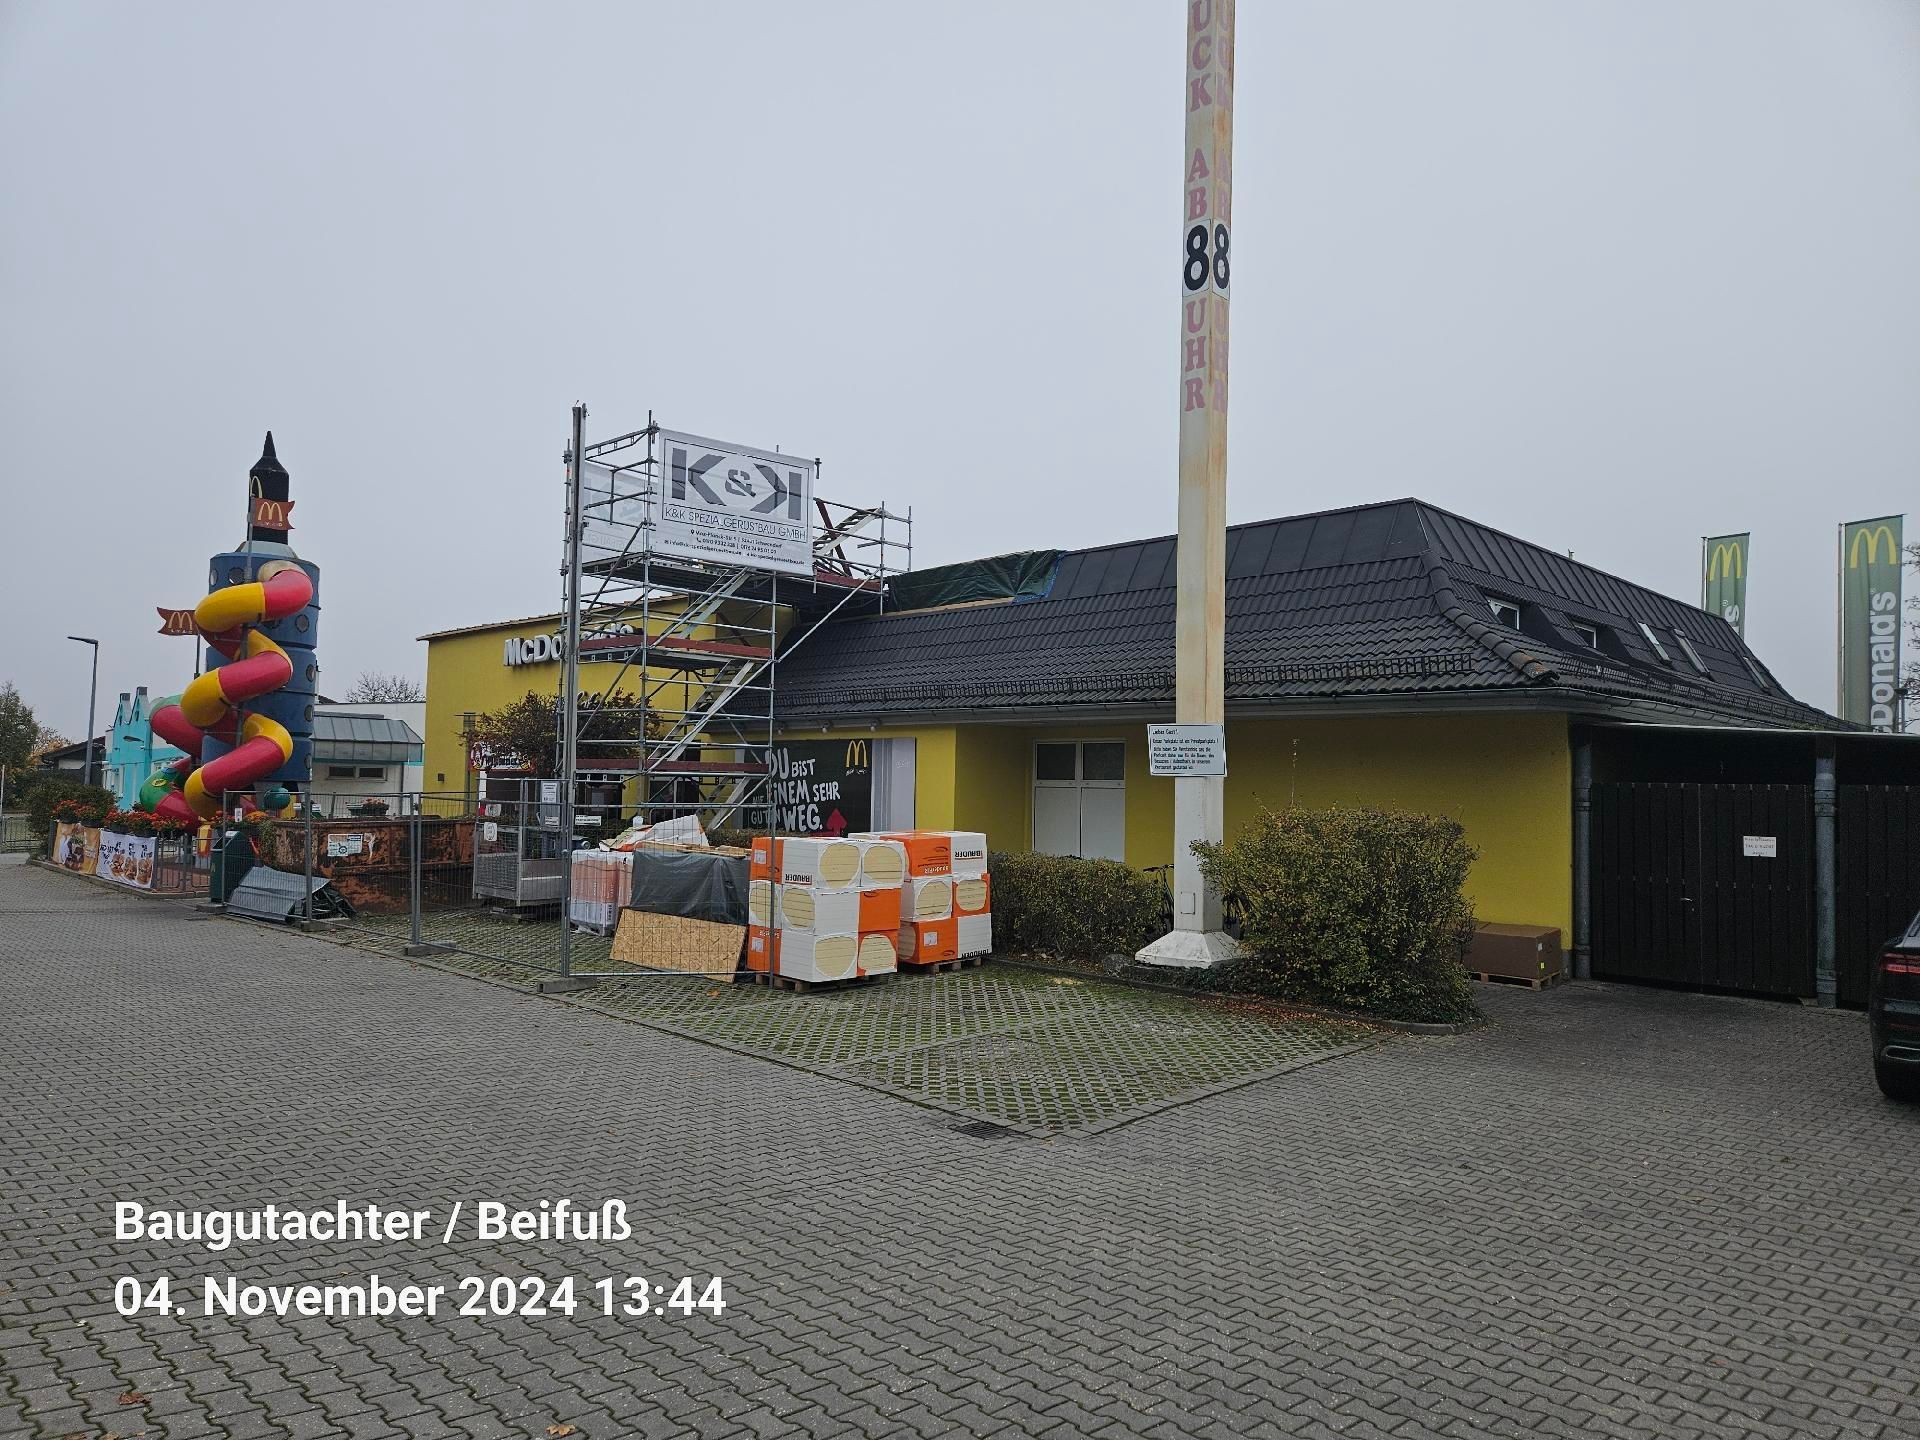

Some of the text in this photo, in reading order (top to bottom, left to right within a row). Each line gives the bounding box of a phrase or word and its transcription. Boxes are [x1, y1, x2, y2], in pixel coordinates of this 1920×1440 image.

[1188, 148, 1209, 221] AB
[1184, 224, 1209, 291] 8
[1213, 223, 1230, 290] 8
[1184, 298, 1207, 412] UHR
[765, 747, 789, 779] DU
[813, 781, 841, 802] SEHR
[782, 804, 823, 832] WEG.
[955, 850, 982, 859] BAUDER
[785, 873, 812, 884] BAUDER
